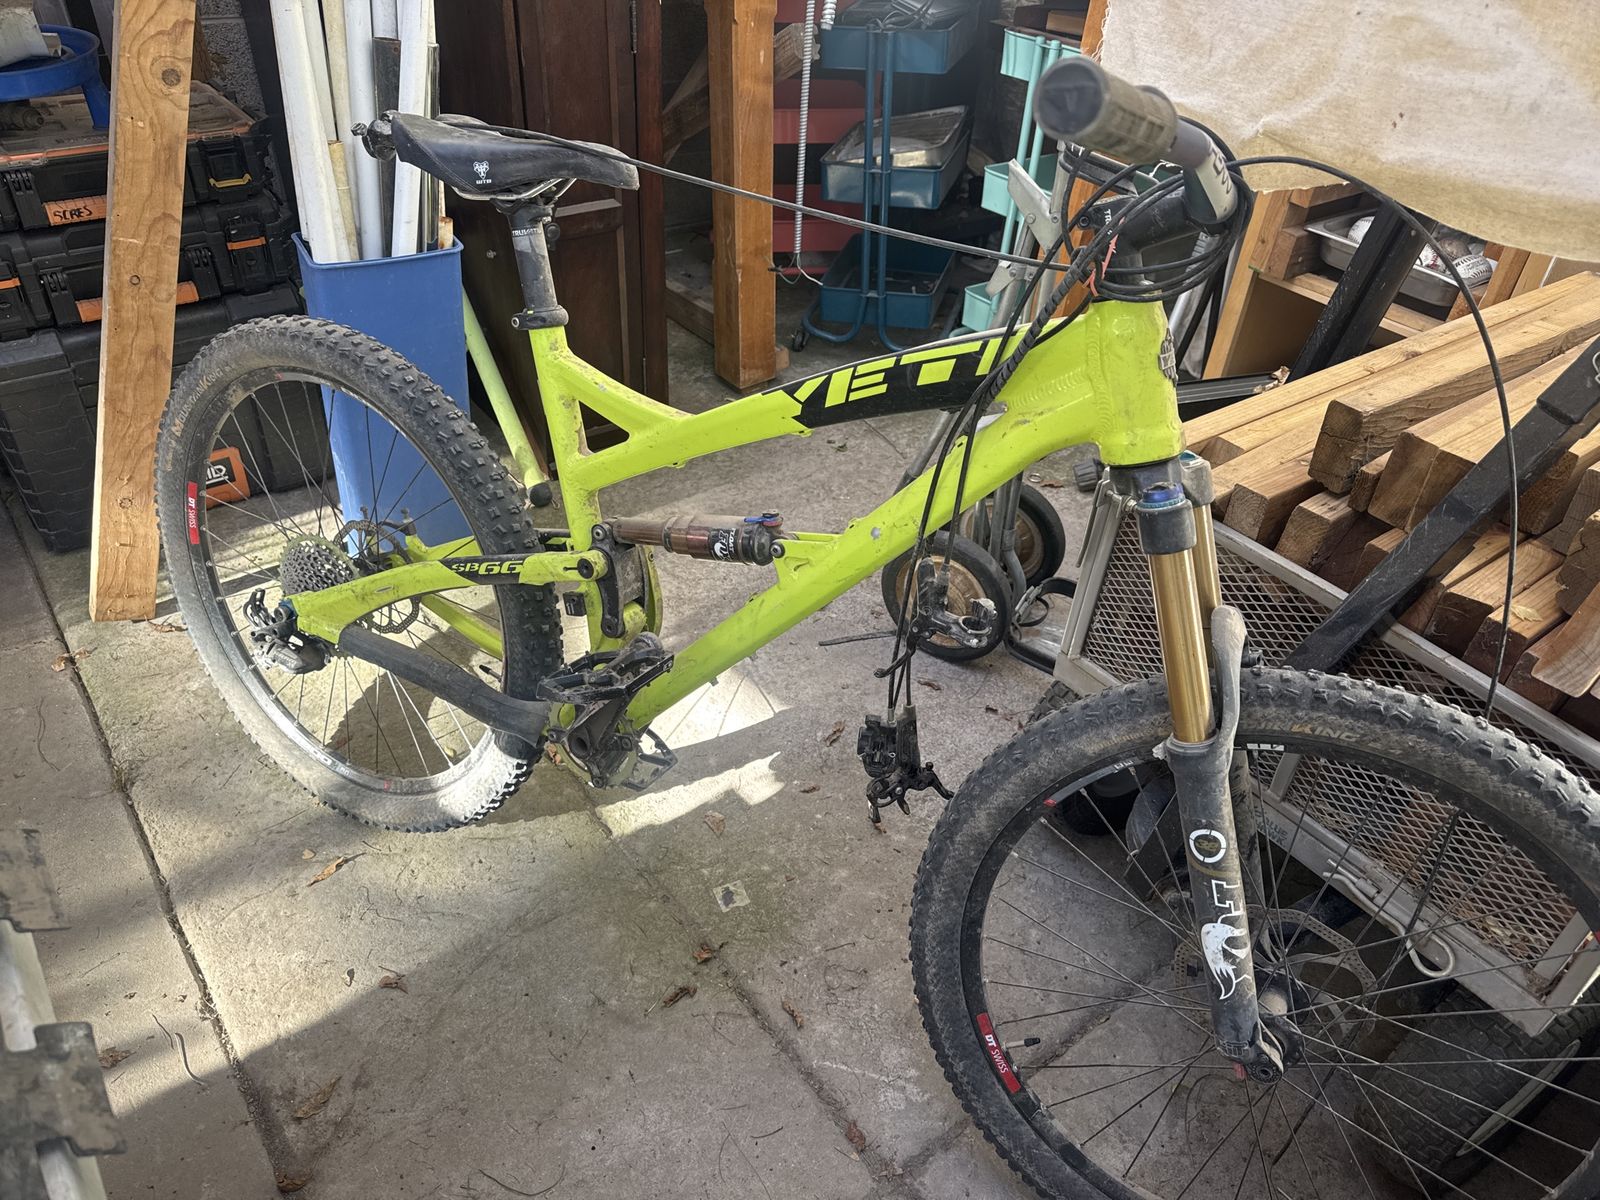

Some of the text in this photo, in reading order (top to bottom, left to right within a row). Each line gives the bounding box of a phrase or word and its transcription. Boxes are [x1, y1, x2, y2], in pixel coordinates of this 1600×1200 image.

[793, 337, 1003, 408] YETI
[188, 508, 197, 529] SWISS
[985, 1034, 1009, 1074] DT SWISS
